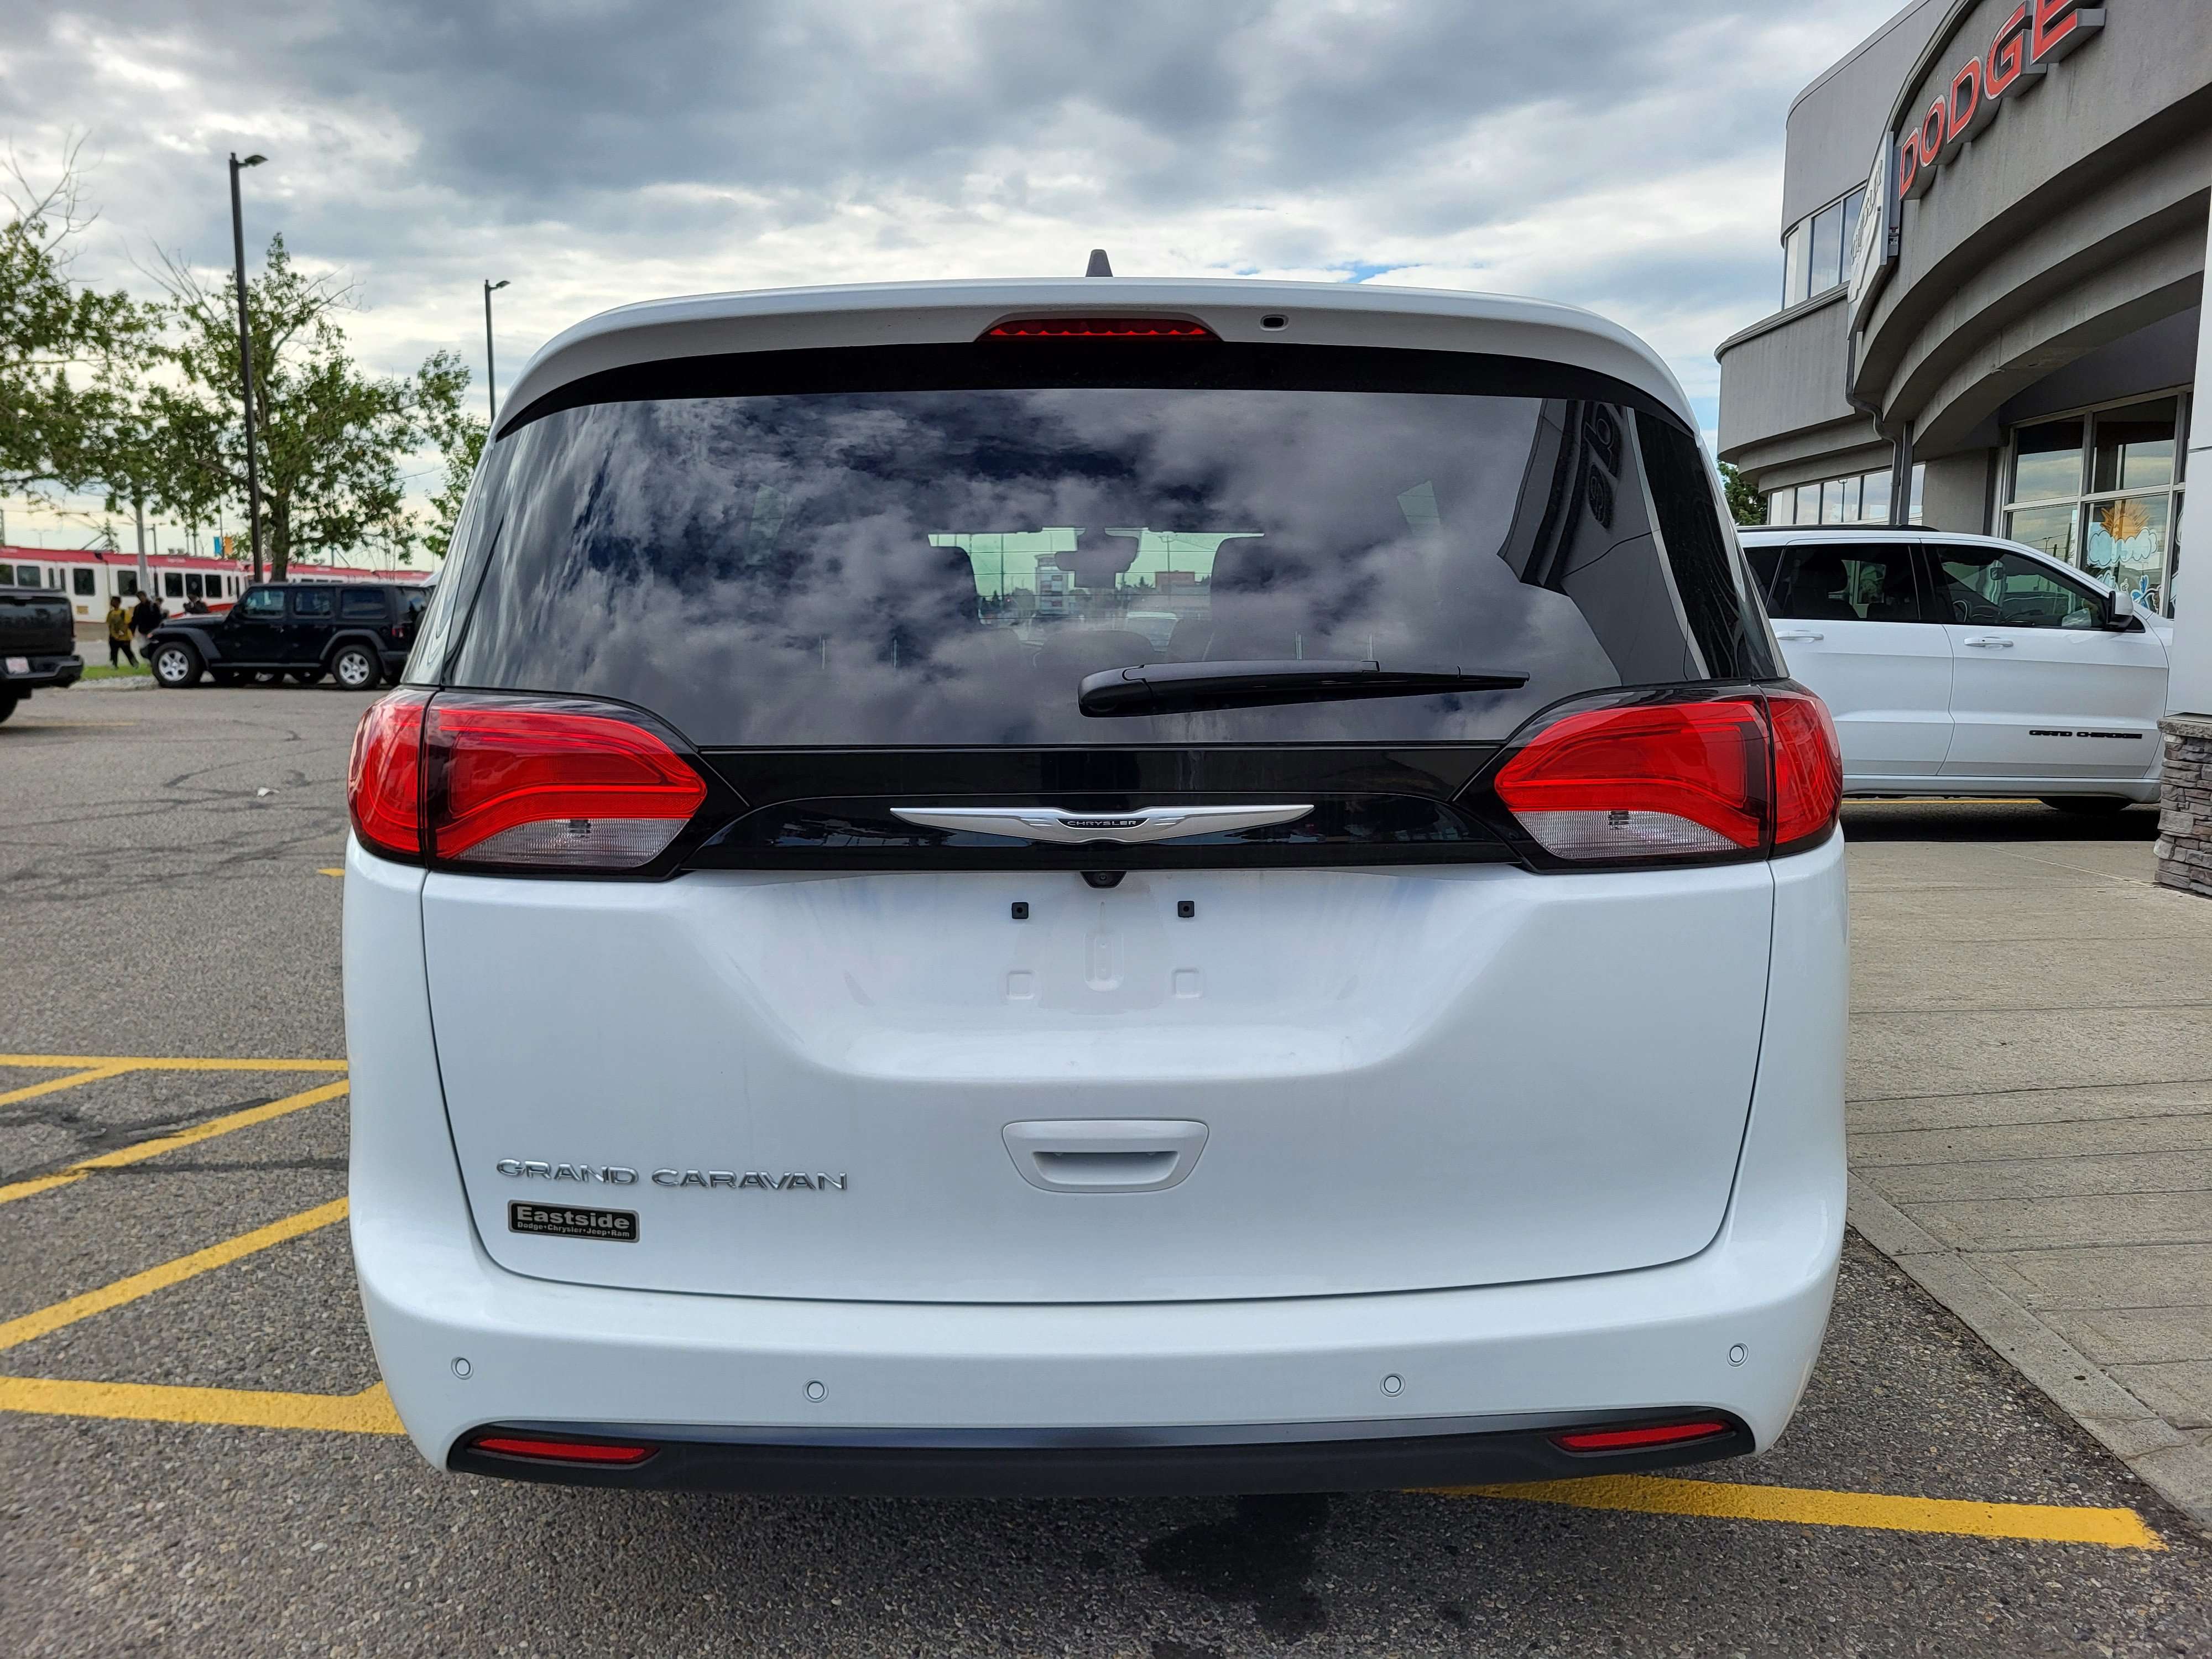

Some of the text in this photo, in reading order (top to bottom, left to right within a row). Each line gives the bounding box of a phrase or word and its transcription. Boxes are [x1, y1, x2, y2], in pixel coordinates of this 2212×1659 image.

[1899, 0, 2079, 201] DODGE
[496, 1159, 848, 1191] GRAND CARAVAN
[516, 1206, 630, 1229] Eastside
